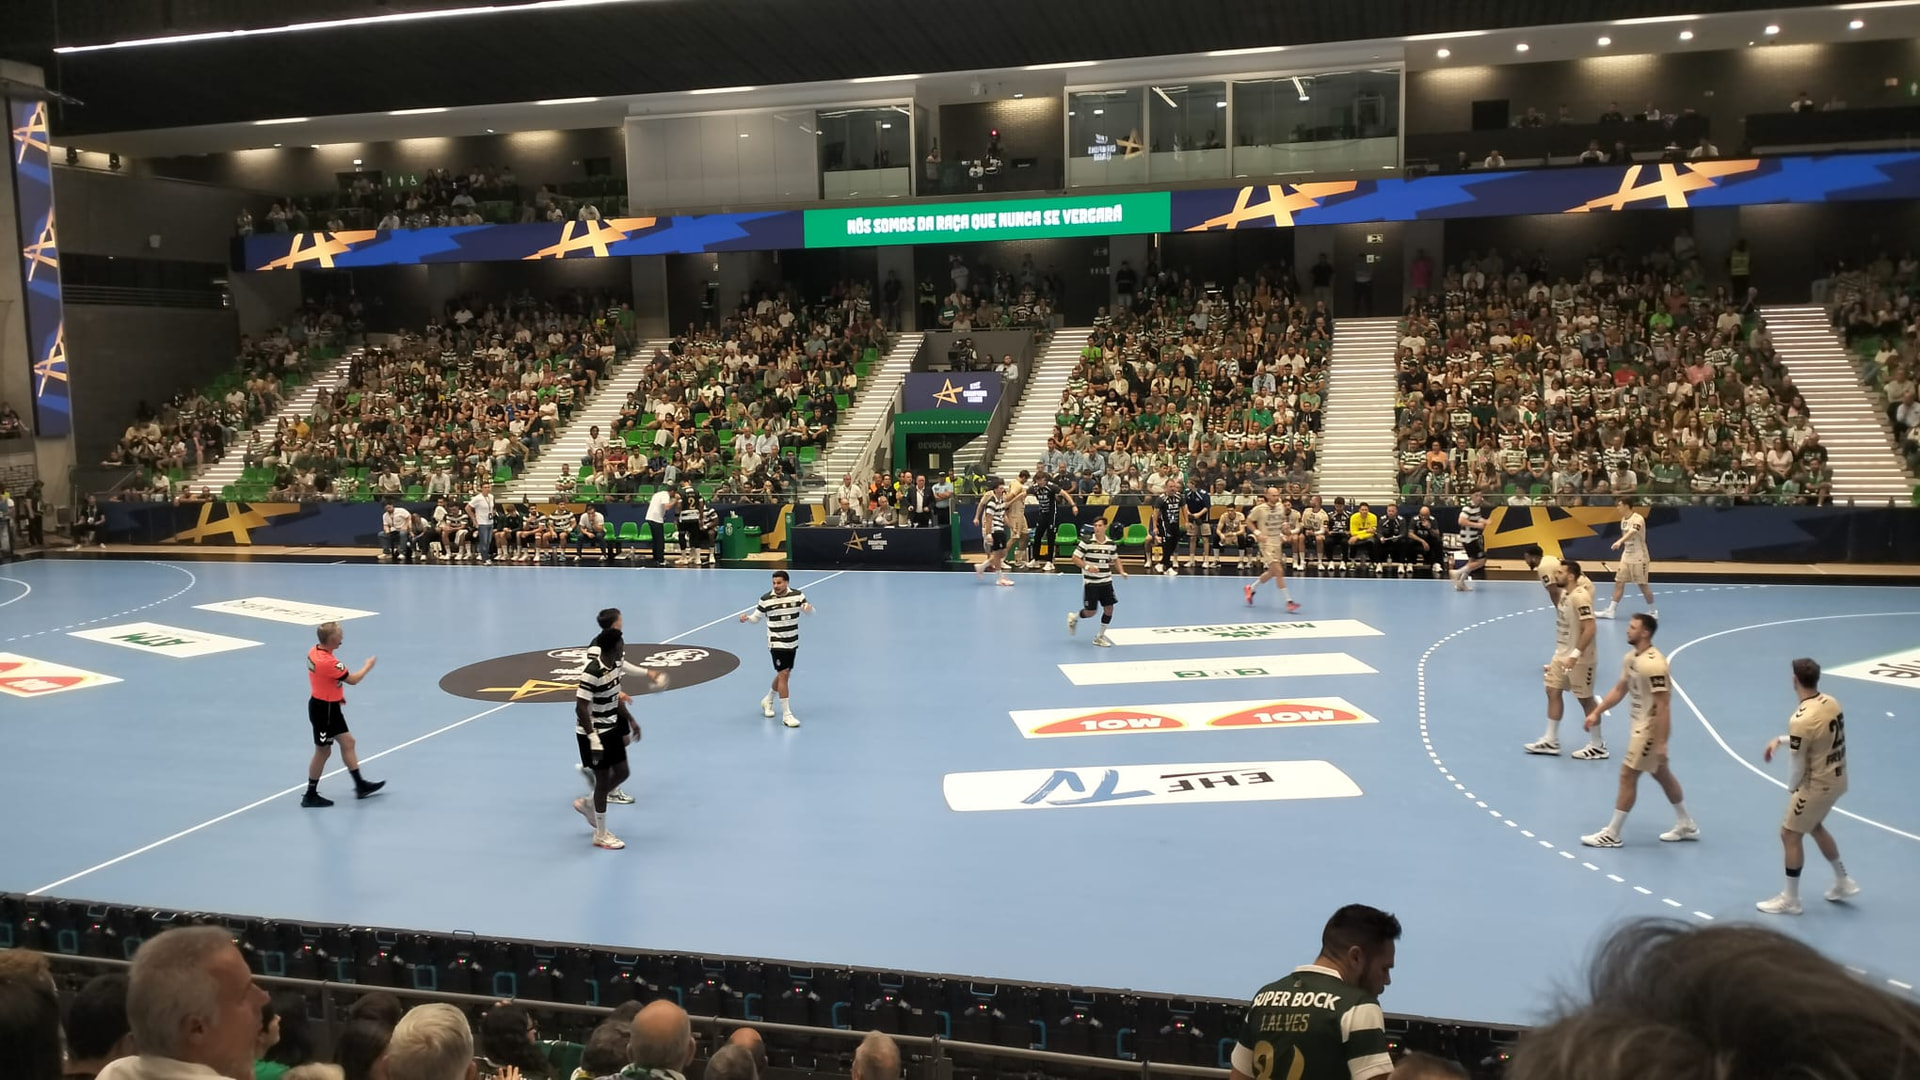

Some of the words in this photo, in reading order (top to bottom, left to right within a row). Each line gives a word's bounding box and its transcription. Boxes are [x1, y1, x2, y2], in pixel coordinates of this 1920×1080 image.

[847, 217, 872, 235] NÓS
[873, 216, 915, 233] SOMOS
[917, 215, 934, 232] DA
[936, 213, 970, 232] RAÇA
[971, 213, 997, 231] QUE
[998, 211, 1041, 228] NUNCA
[1043, 210, 1061, 226] SE
[1062, 204, 1123, 224] VERGARÁ
[110, 632, 196, 647] ATM
[1080, 717, 1163, 730] MOL
[1254, 710, 1335, 723] MOL
[1020, 769, 1156, 806] TV
[1168, 771, 1275, 793] EHF
[1252, 991, 1292, 1008] SUPER
[1291, 992, 1342, 1011] BOCK
